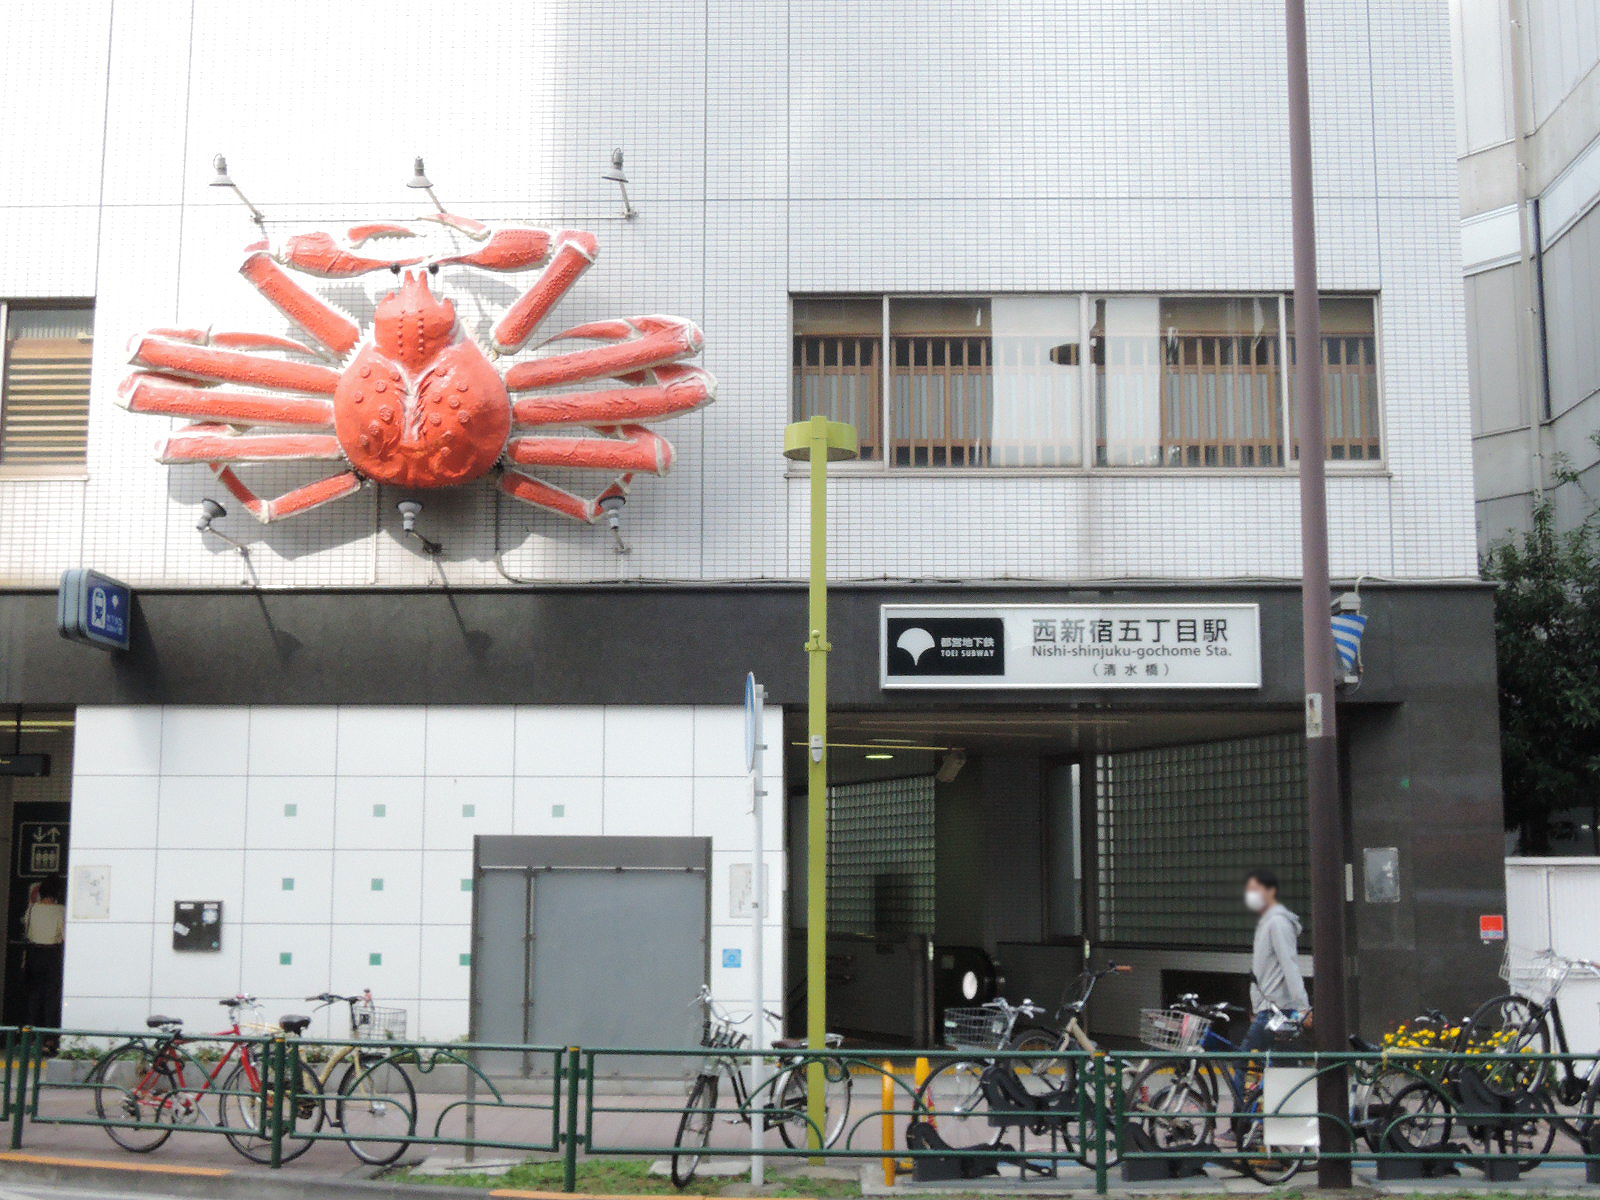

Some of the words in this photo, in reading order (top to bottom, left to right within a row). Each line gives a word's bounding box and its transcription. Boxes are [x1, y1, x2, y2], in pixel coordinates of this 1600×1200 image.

[1032, 618, 1228, 643] 西新宿五丁目駅
[961, 649, 995, 657] SUBWAY
[1032, 645, 1201, 660] Nishi-shinjuku-gochome
[1205, 645, 1232, 657] Sta.
